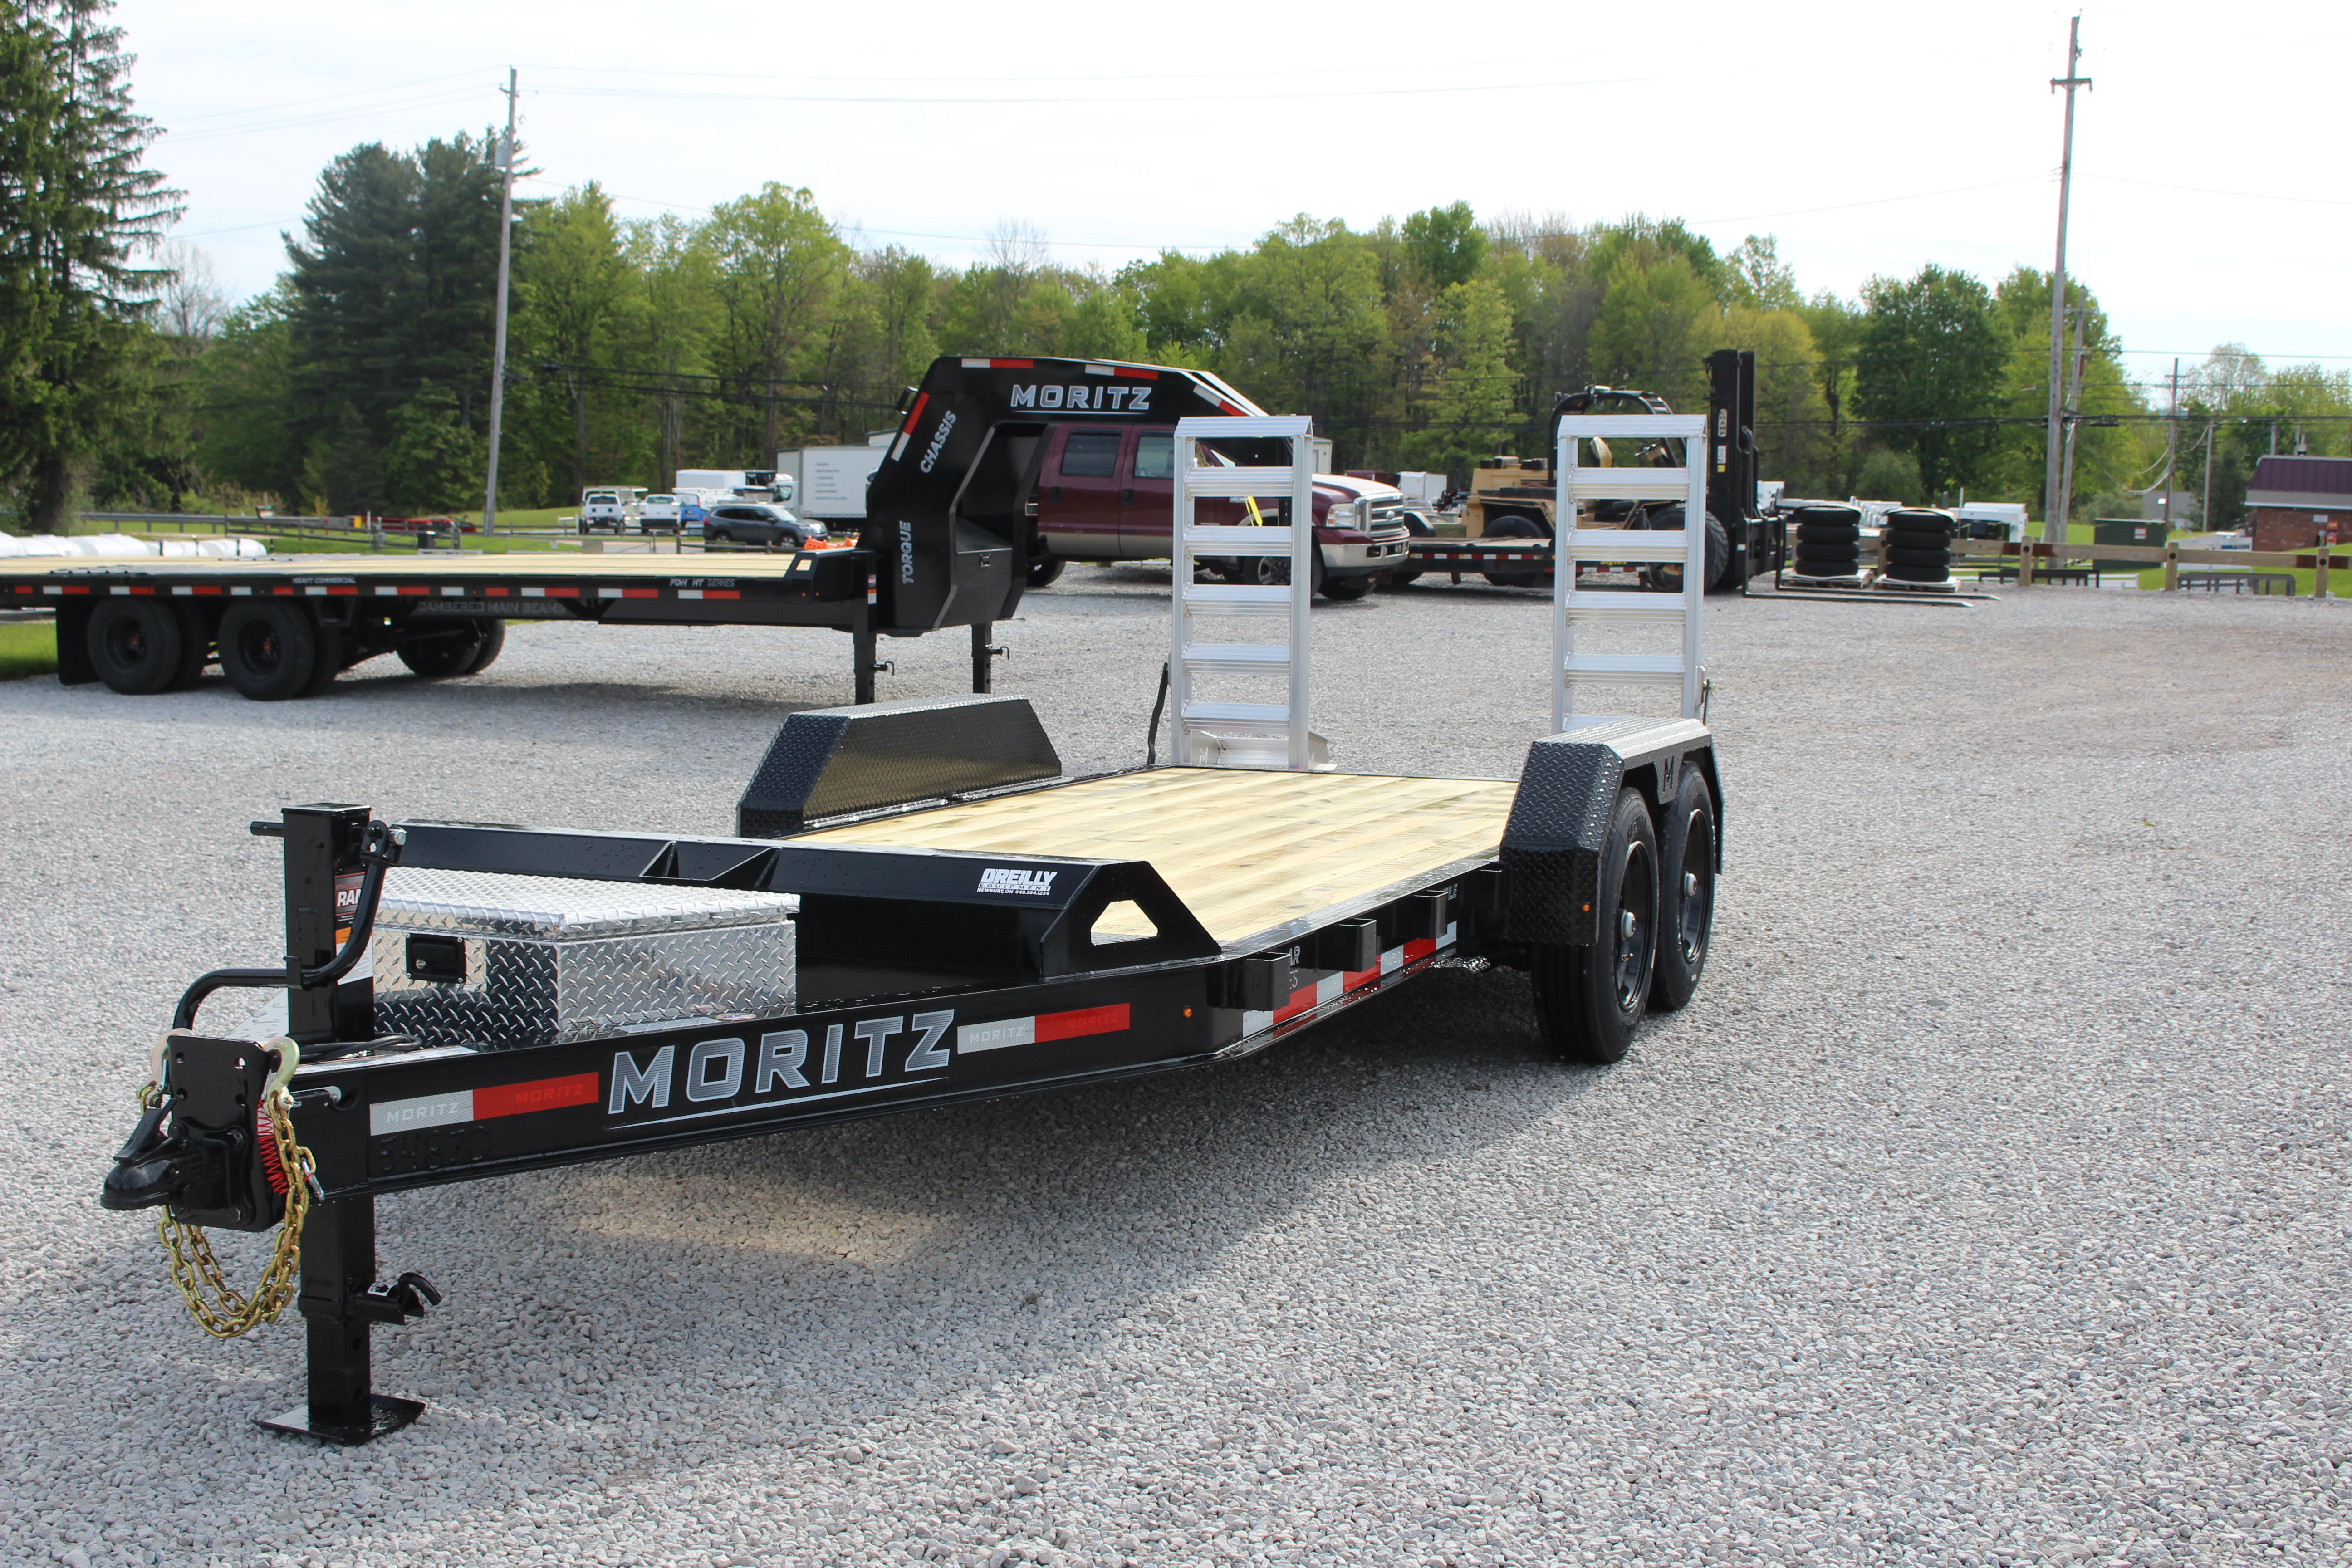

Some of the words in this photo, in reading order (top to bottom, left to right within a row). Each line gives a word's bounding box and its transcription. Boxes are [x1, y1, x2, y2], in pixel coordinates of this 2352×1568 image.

[1010, 384, 1152, 410] MORITZ
[920, 410, 956, 473] CHASSIS
[899, 520, 914, 584] TORQUE
[707, 579, 735, 587] SERIES
[418, 601, 485, 612] CAMBERED
[488, 602, 519, 613] MAIN
[522, 602, 566, 614] BEAMS
[970, 1026, 1024, 1044] MORITZ
[1067, 1013, 1119, 1029] MORITZ
[608, 1009, 955, 1115] MORITZ
[387, 1101, 460, 1124] MORITZ
[516, 1083, 585, 1104] MORITZ
